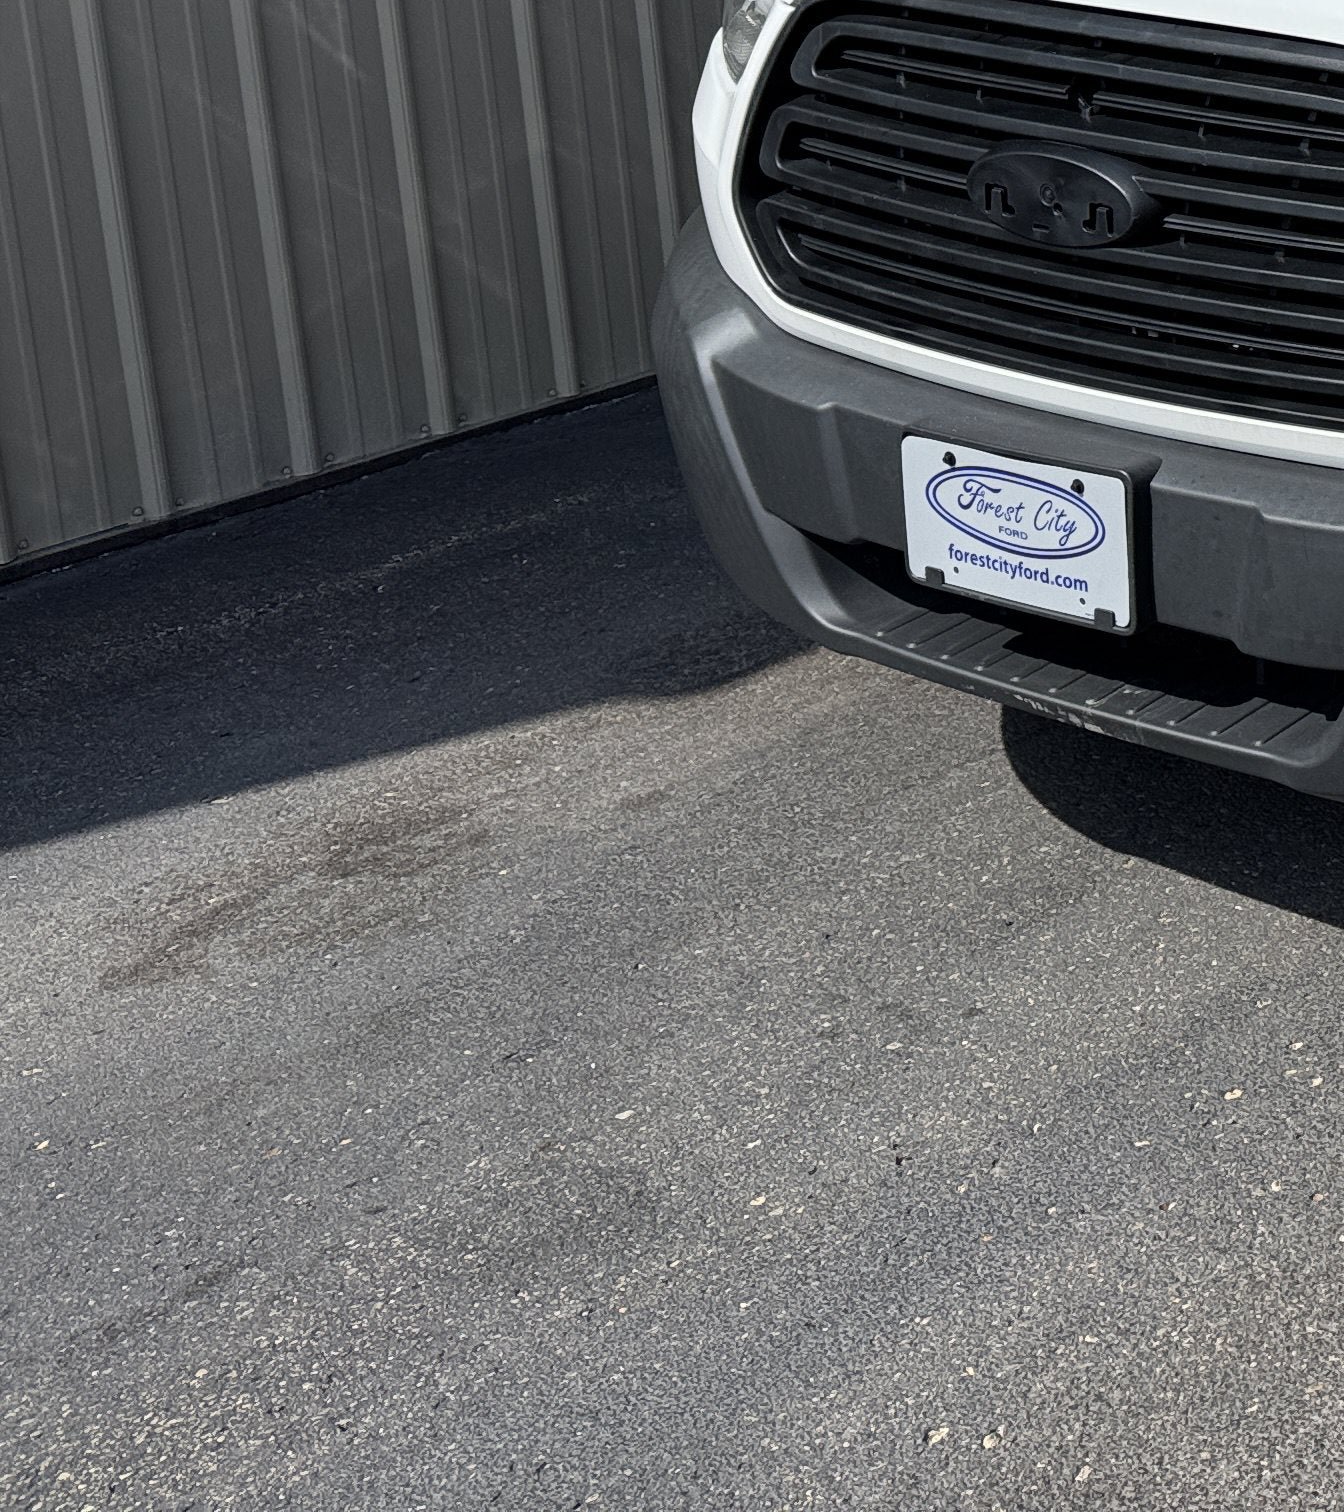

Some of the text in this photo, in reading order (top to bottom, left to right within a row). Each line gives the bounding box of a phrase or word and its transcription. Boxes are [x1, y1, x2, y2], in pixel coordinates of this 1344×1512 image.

[957, 478, 1077, 547] Forest City
[998, 525, 1028, 540] FORD
[948, 543, 1089, 592] forestcityford.com
